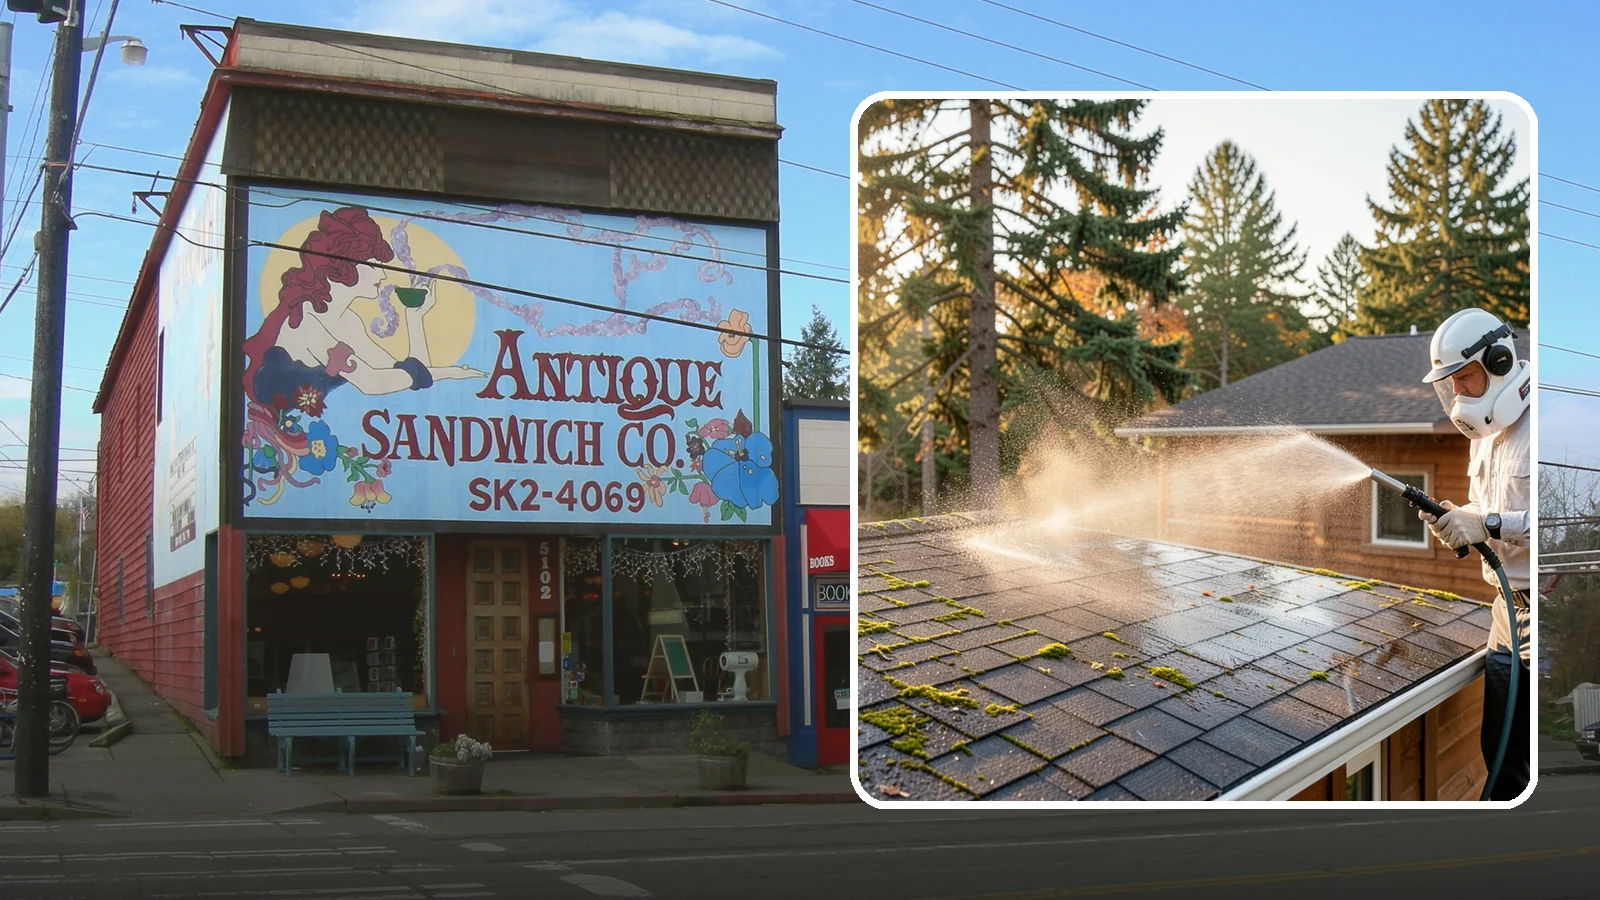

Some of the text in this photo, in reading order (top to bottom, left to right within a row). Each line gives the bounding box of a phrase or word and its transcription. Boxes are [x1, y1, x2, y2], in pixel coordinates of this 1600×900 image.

[475, 328, 724, 421] ANTIQUE
[361, 408, 684, 469] SANDWICH CO.
[468, 476, 645, 513] SK2-4069
[540, 541, 551, 600] 5102
[809, 555, 835, 569] BOOKS
